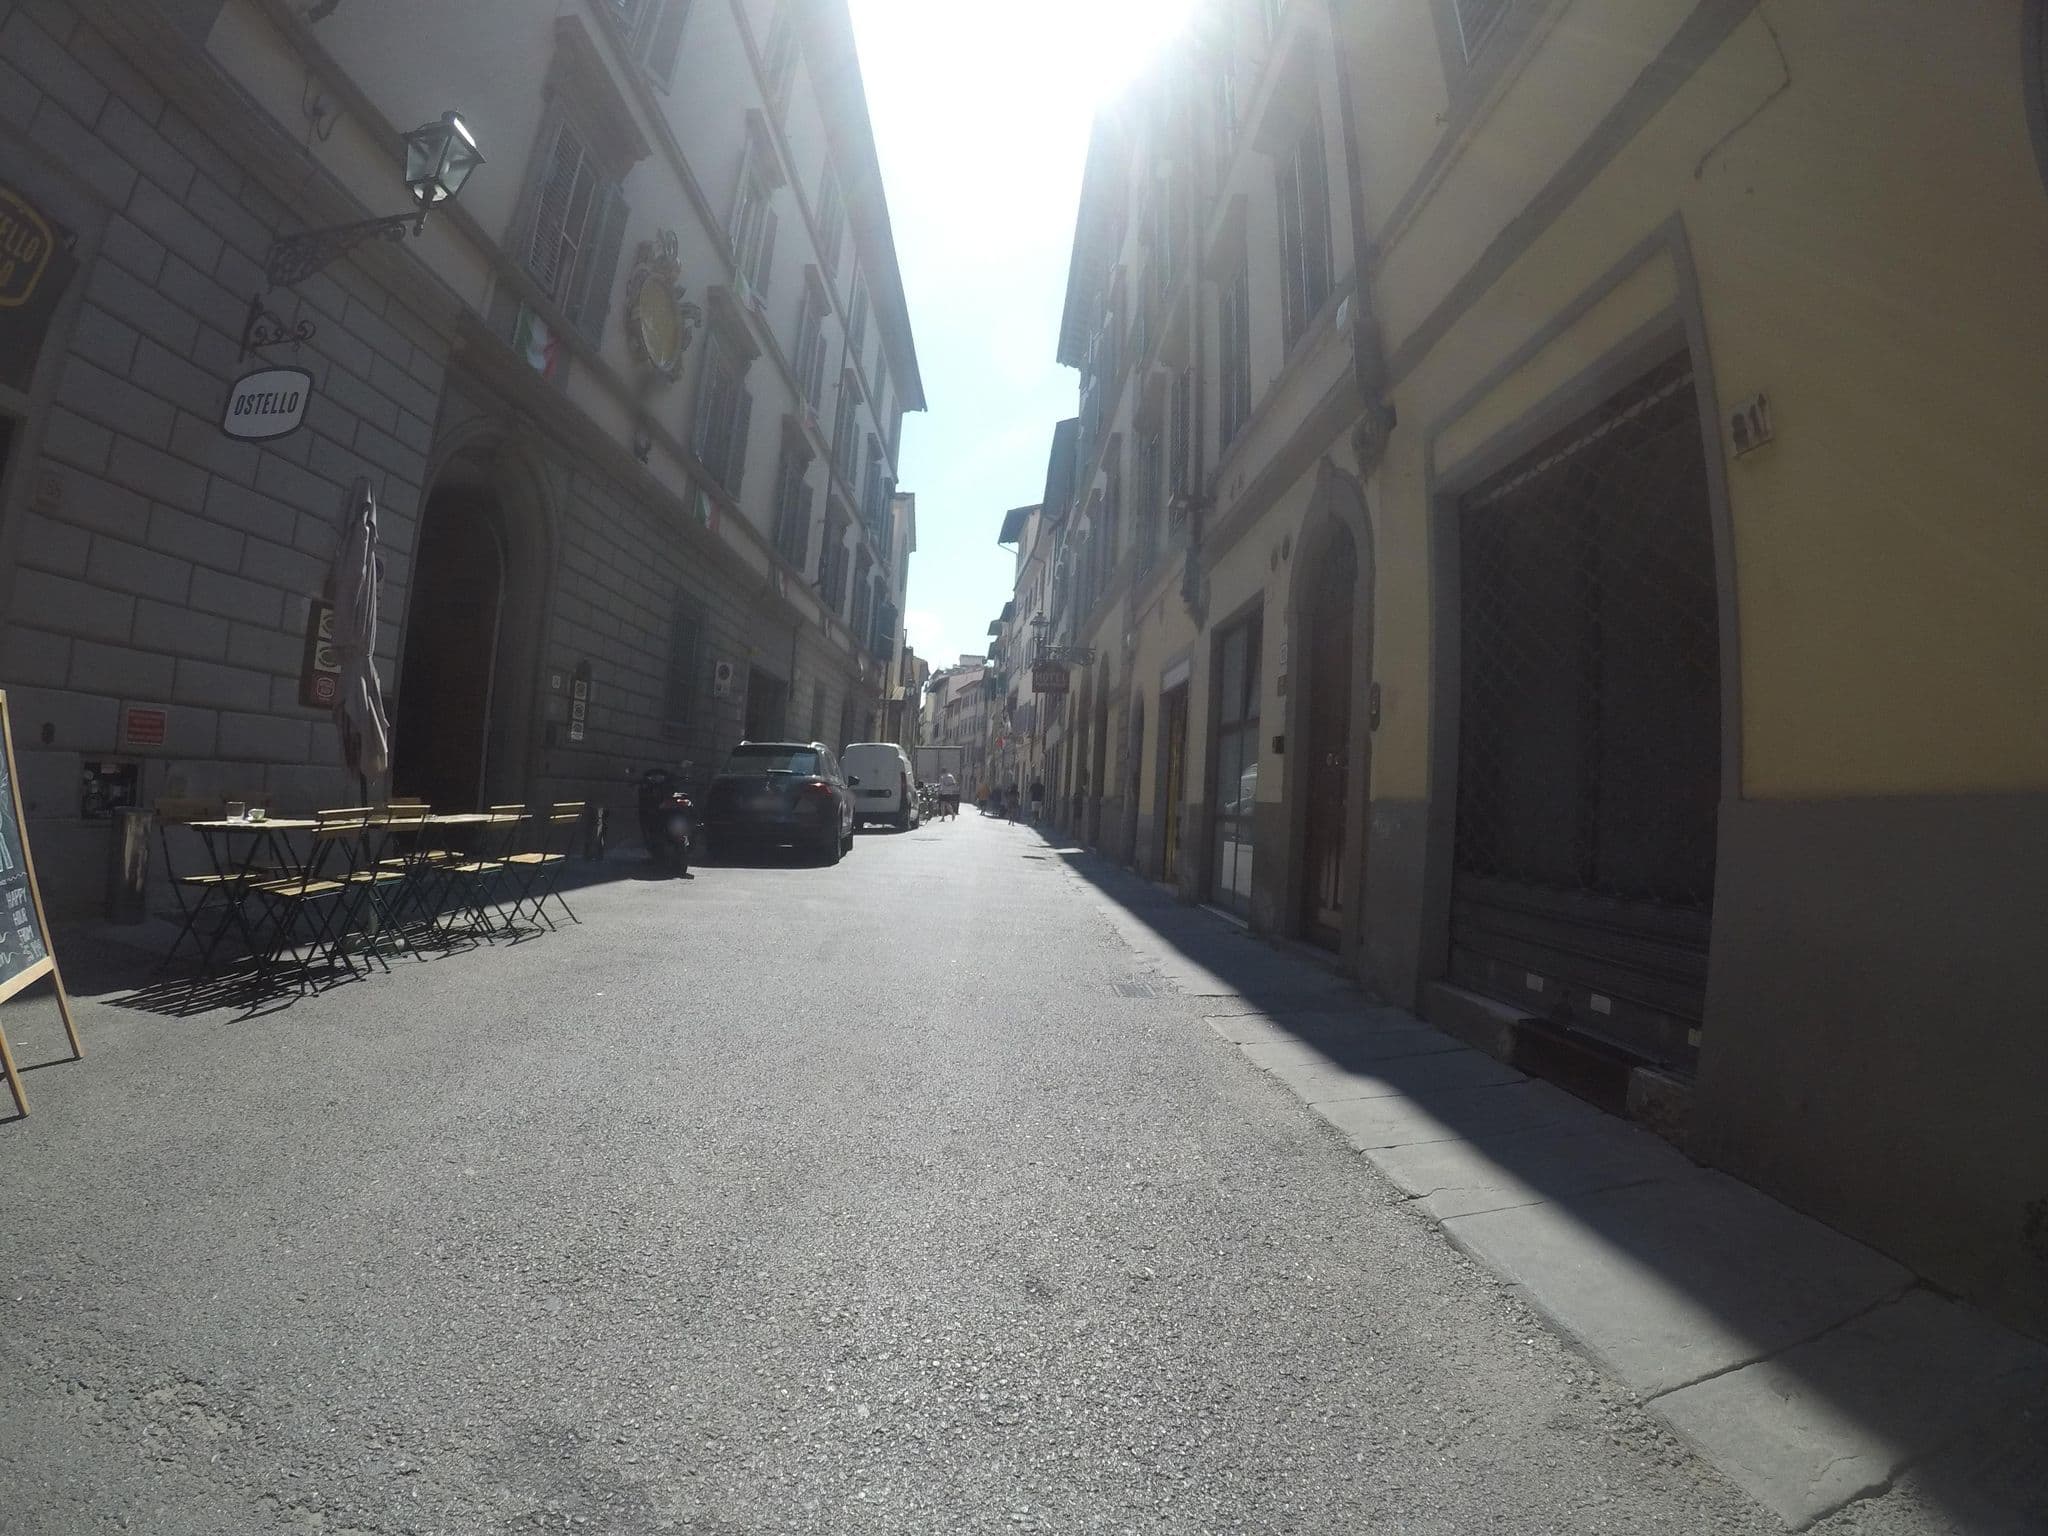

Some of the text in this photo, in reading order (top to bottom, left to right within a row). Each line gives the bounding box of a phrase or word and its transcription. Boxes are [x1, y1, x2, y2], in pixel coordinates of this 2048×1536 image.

[233, 391, 300, 417] OSTELLO
[1035, 671, 1067, 682] HOTEL
[5, 886, 28, 910] HAPPY
